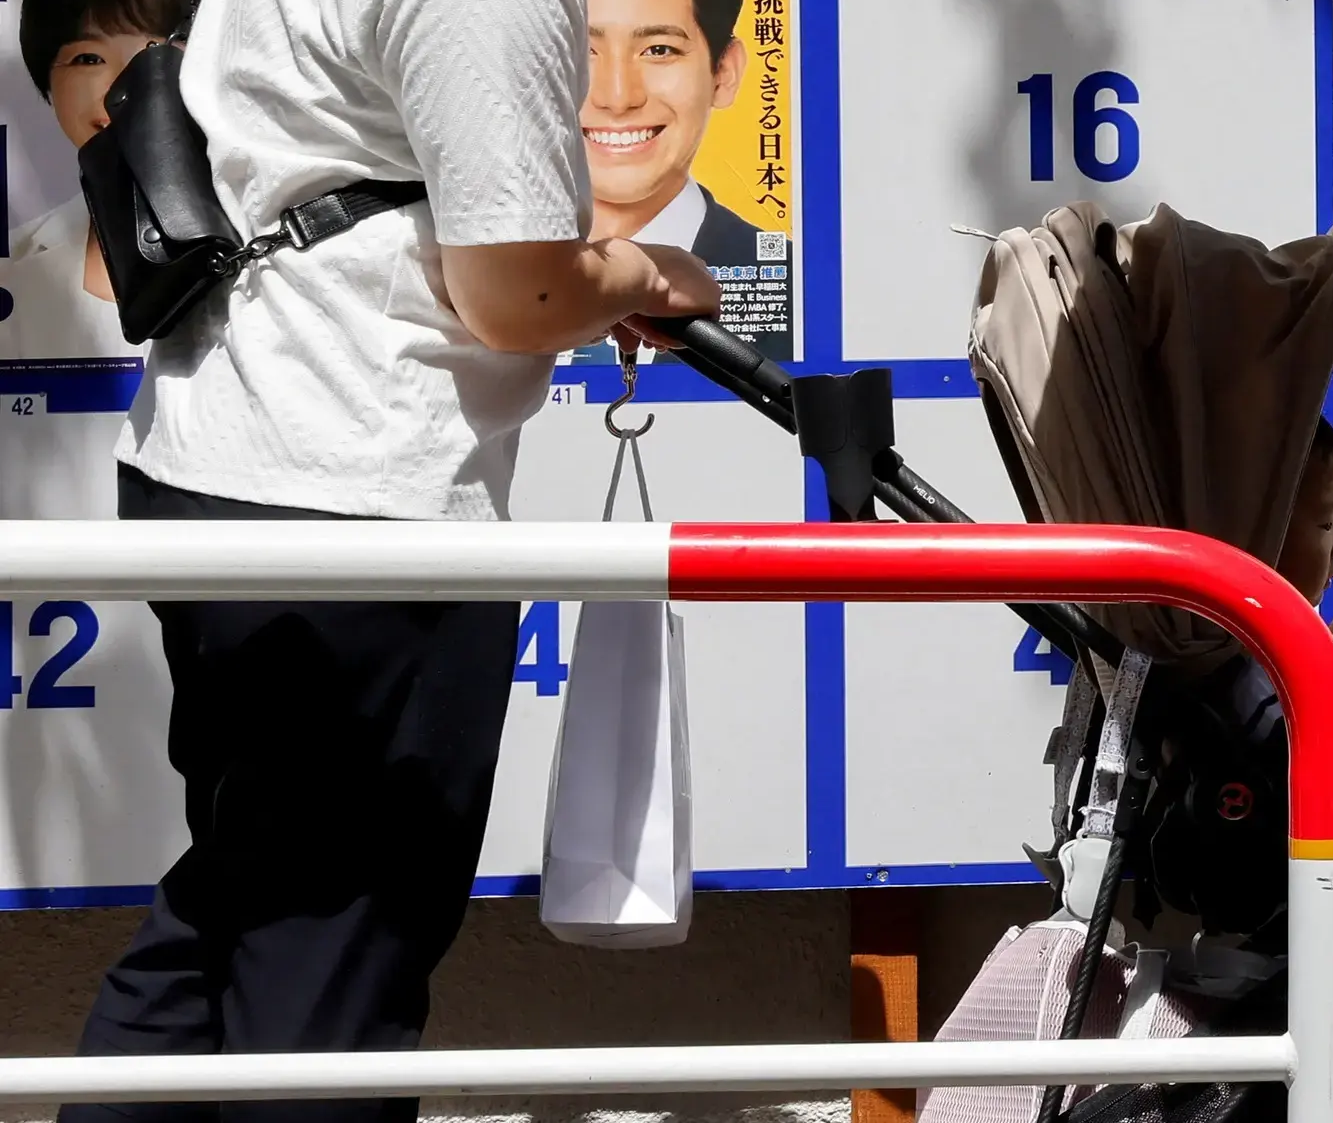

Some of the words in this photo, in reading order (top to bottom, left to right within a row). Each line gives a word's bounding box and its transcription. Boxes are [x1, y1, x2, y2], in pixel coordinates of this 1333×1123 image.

[1017, 70, 1140, 183] 16
[552, 387, 571, 404] 41
[11, 397, 34, 415] 42
